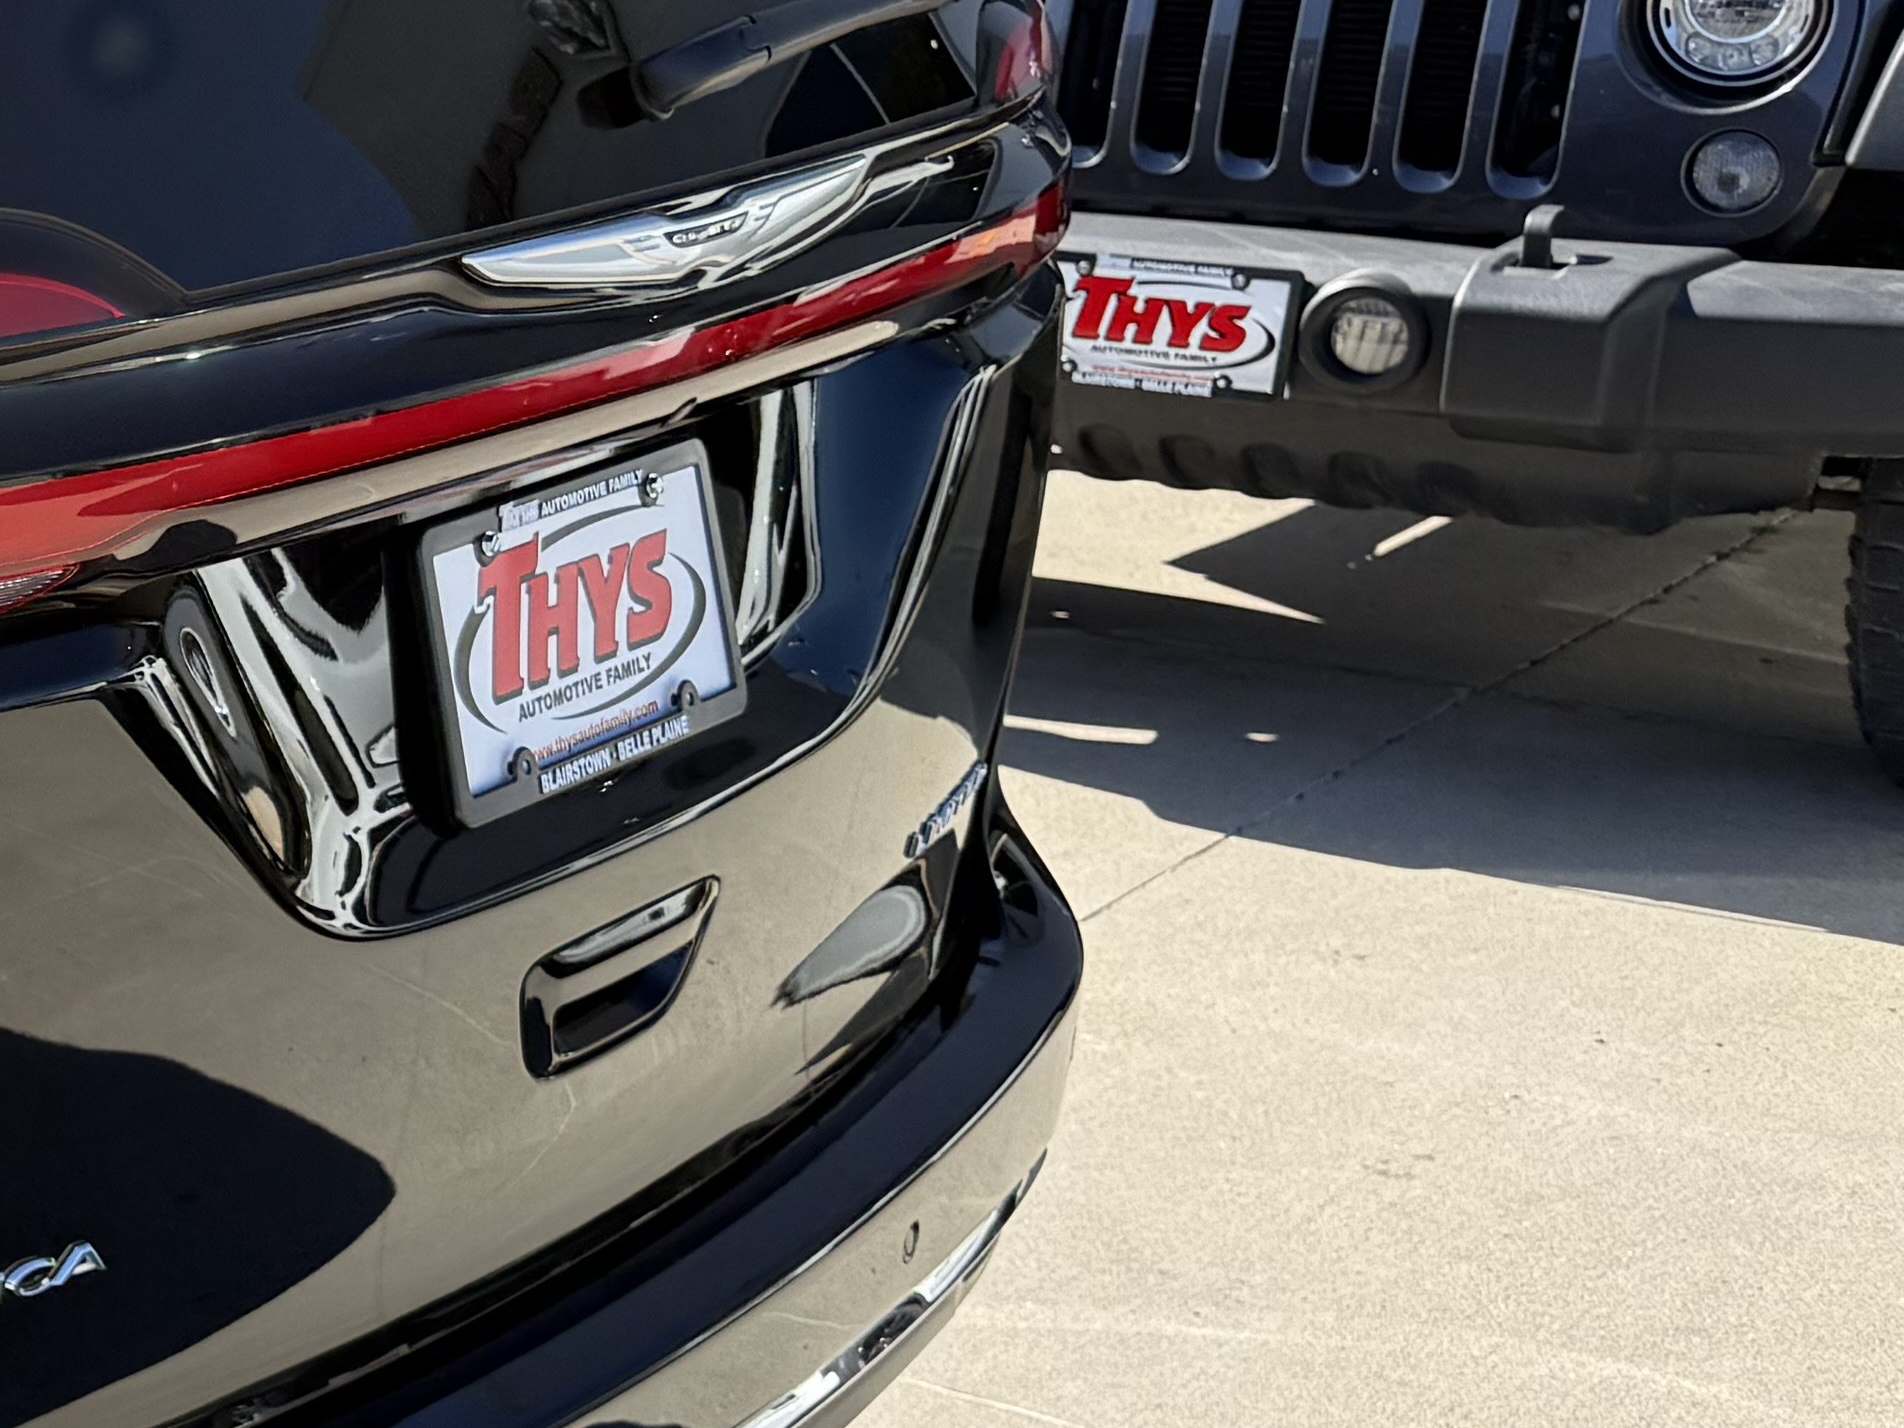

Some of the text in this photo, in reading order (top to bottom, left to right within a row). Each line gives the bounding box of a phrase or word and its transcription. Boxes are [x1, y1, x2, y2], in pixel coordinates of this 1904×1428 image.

[1071, 274, 1252, 353] THYS
[541, 480, 608, 517] AUTOMOTIVE
[609, 469, 643, 494] FAMILY
[477, 529, 673, 705] THYS
[519, 652, 653, 723] AUTOMOTIVE FAMILY
[541, 715, 690, 794] BLAIRSTOWN BELLE PLAINE
